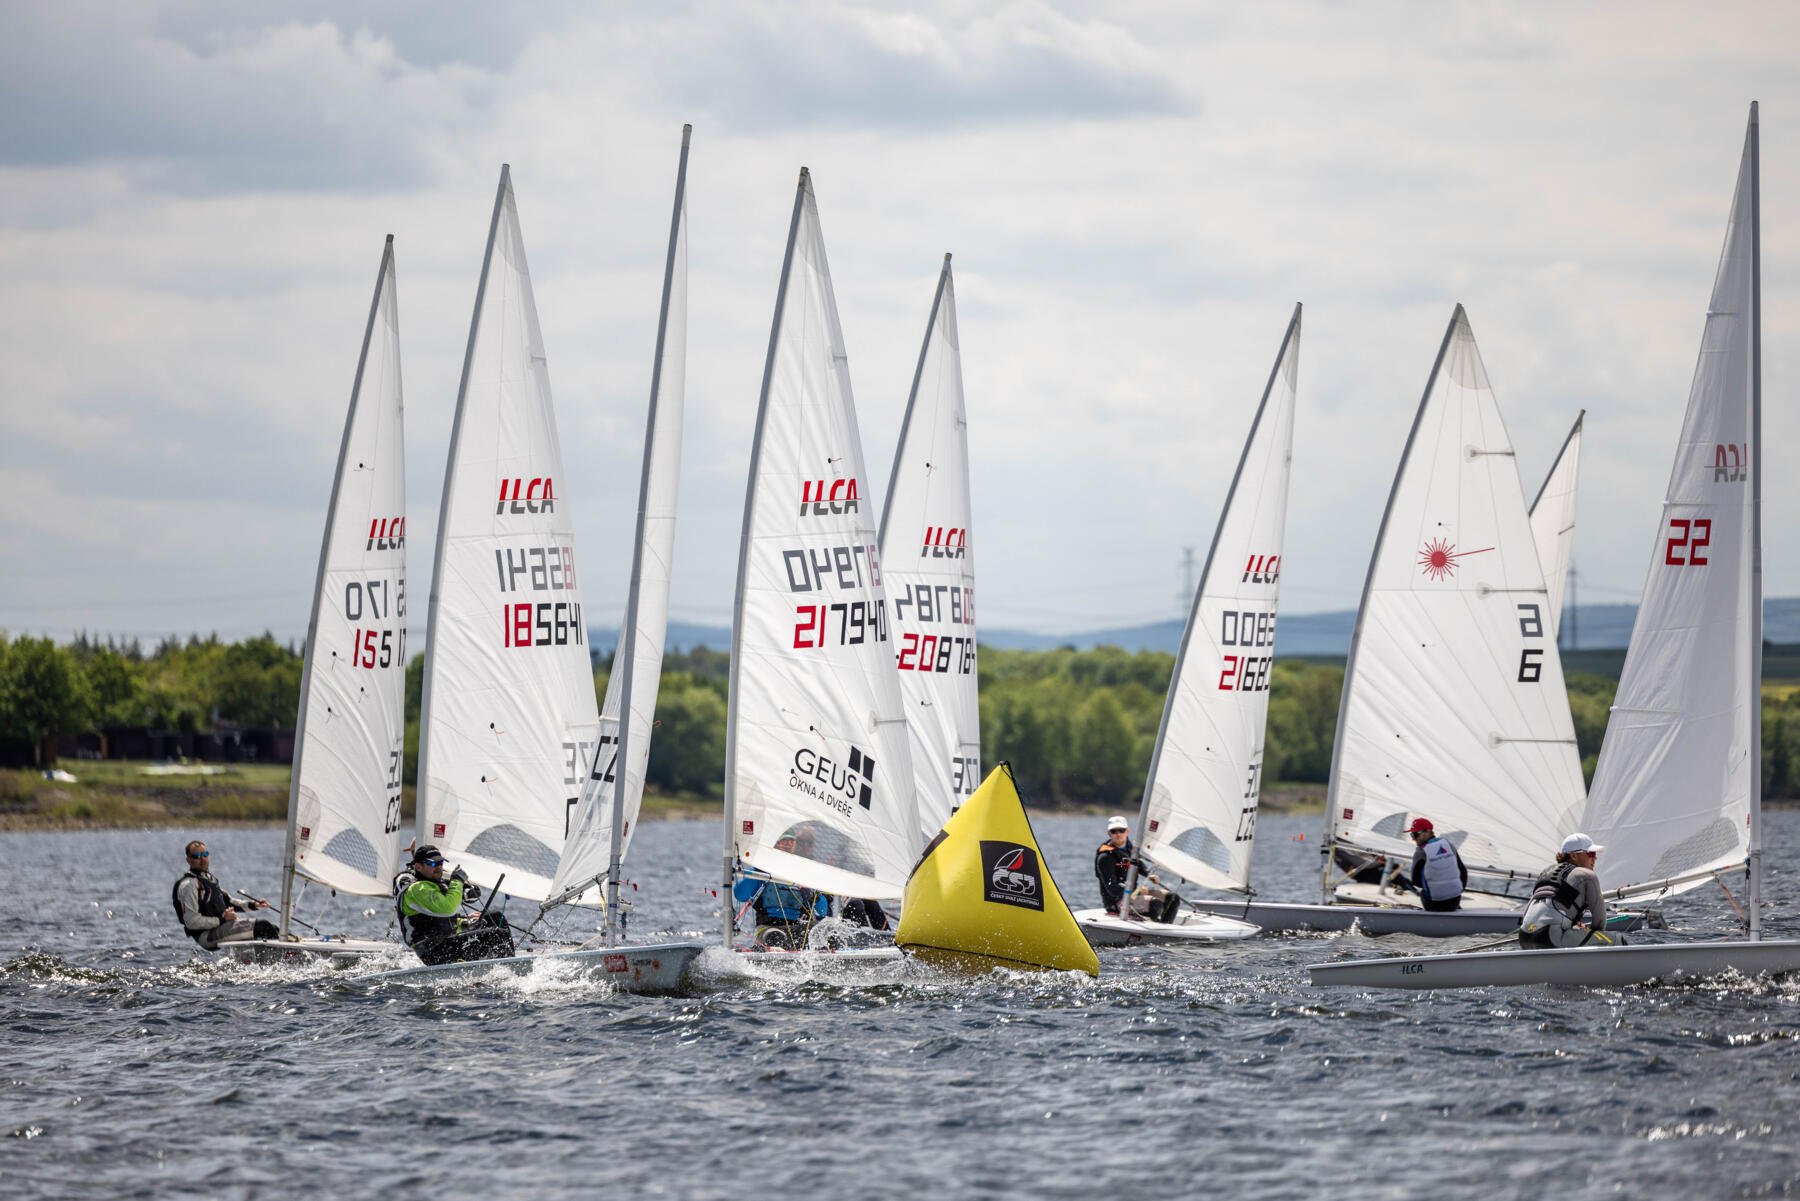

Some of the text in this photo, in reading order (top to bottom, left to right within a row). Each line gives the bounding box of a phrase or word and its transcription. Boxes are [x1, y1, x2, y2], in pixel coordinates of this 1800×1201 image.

[496, 478, 554, 515] ILCA
[800, 478, 859, 517] ILCA
[366, 516, 406, 551] ILCA
[921, 527, 966, 559] ILCA
[1665, 519, 1712, 566] 22
[504, 603, 583, 648] 185641
[793, 600, 887, 648] 217940
[1518, 649, 1543, 682] 6
[795, 748, 857, 799] GEUS
[789, 776, 853, 818] OKNA A DVEŘE
[1402, 964, 1424, 975] ILCA
